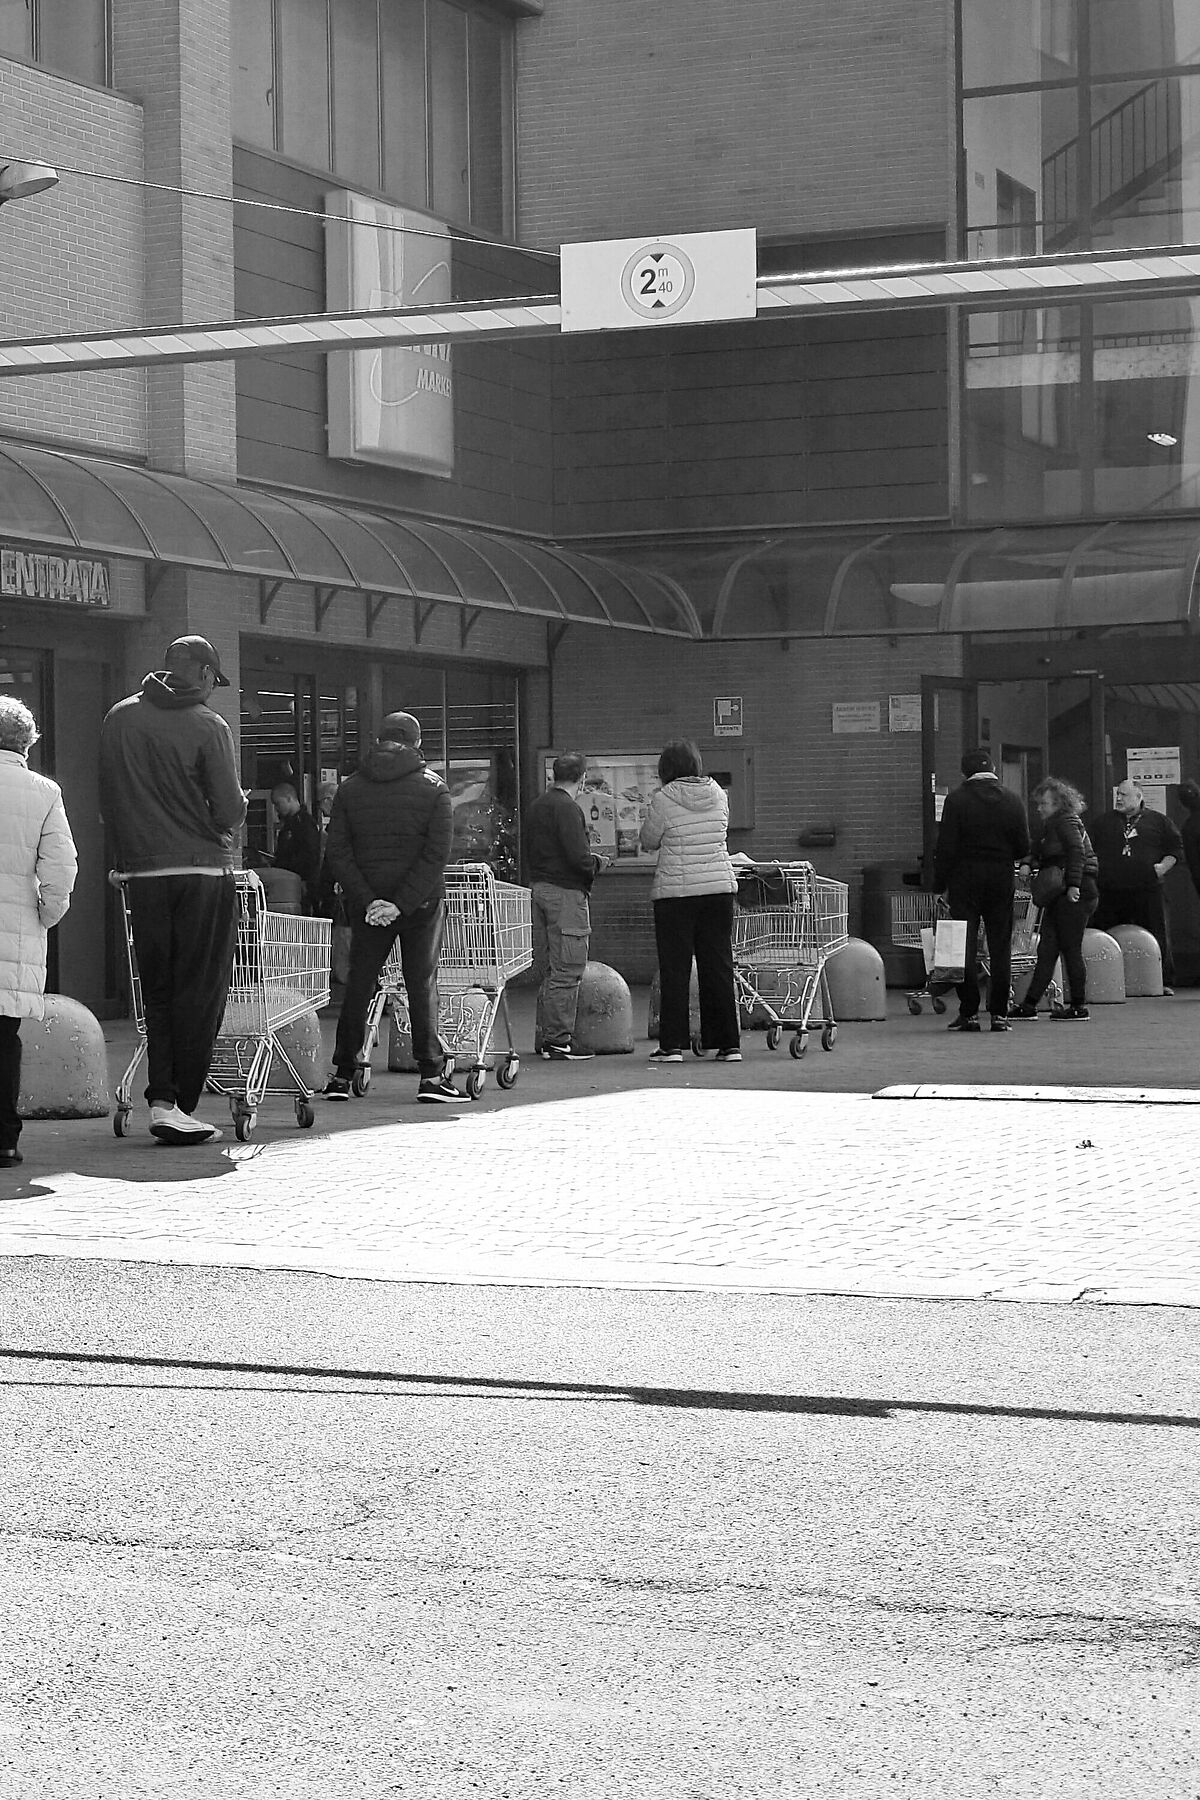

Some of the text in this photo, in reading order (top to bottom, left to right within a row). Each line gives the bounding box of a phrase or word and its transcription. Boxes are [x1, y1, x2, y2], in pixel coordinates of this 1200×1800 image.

[640, 268, 657, 295] 2
[658, 281, 673, 293] 40
[0, 549, 110, 605] ENTRATA
